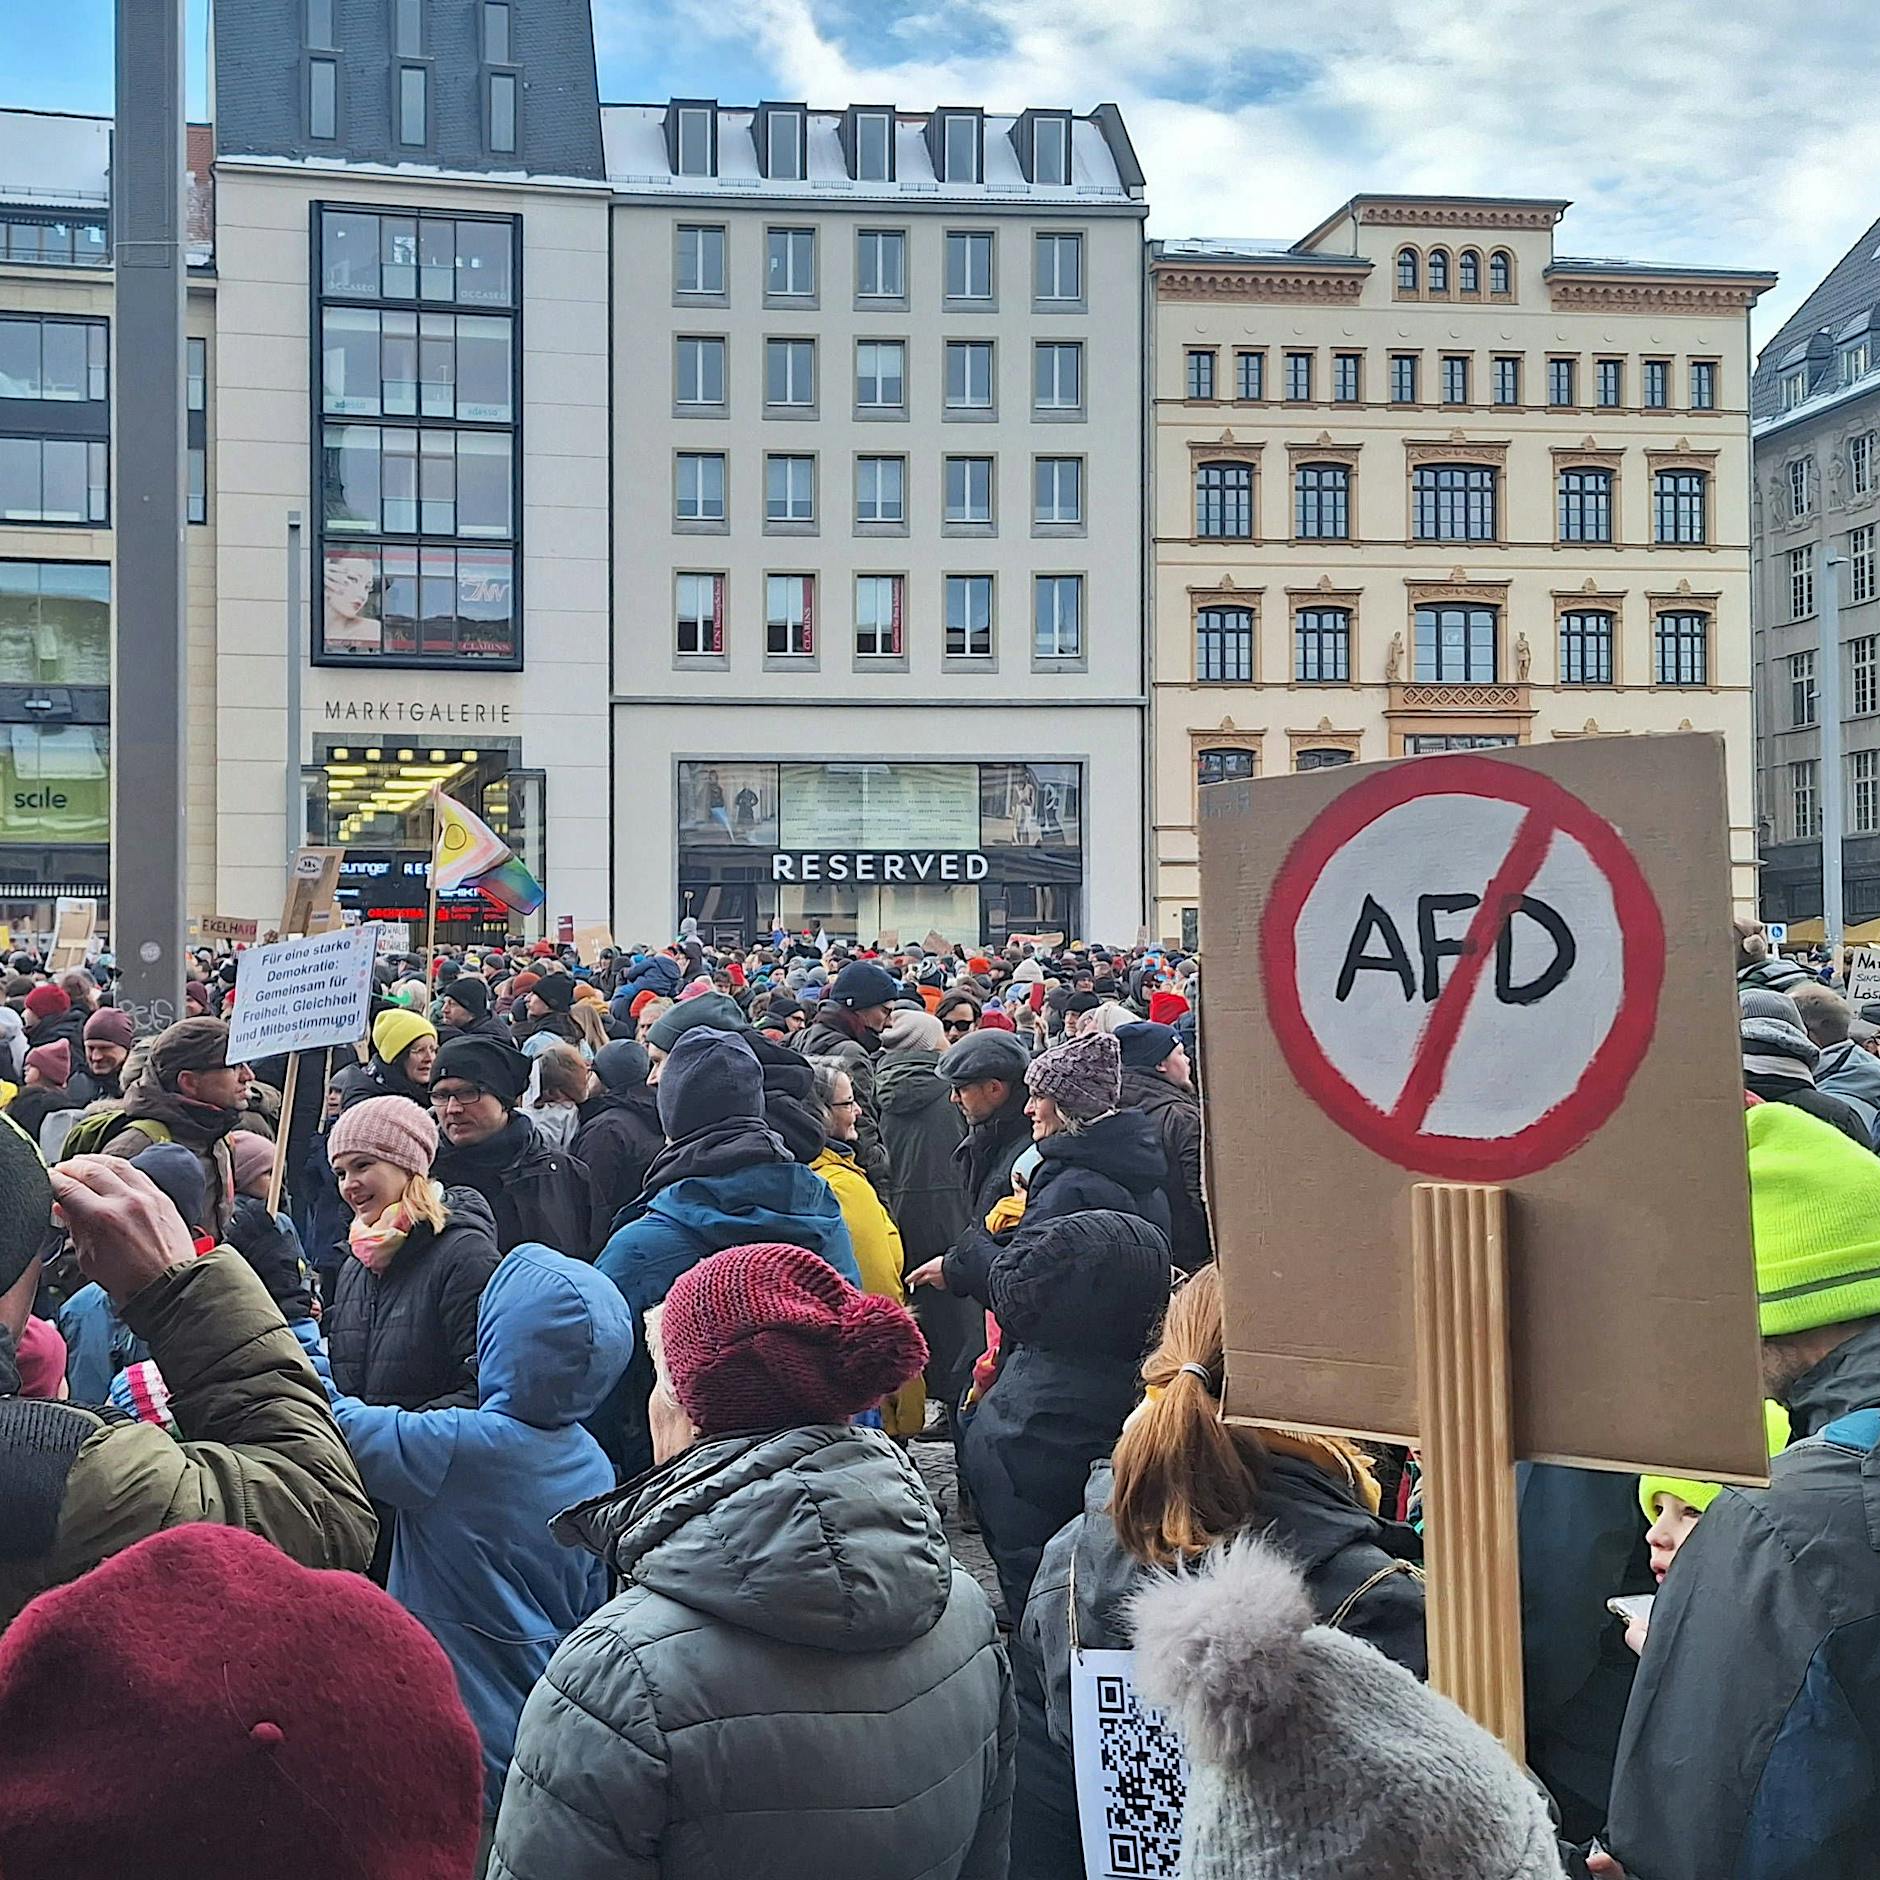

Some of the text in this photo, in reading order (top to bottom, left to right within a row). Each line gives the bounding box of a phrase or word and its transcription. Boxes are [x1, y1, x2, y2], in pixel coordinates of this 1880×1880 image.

[803, 607, 812, 650] CLARINS
[325, 701, 510, 723] MARKTGALERIE
[340, 863, 390, 876] euninger
[403, 863, 432, 875] RES
[772, 853, 989, 881] RESERVED
[262, 939, 351, 966] Für eine starke
[1336, 893, 1576, 1006] AFD
[266, 960, 339, 983] Demokratie:
[255, 976, 348, 1003] Gemeinsam für
[242, 992, 358, 1024] Freiheit, Gleichheit
[236, 1010, 360, 1043] und Mitbestimmung!
